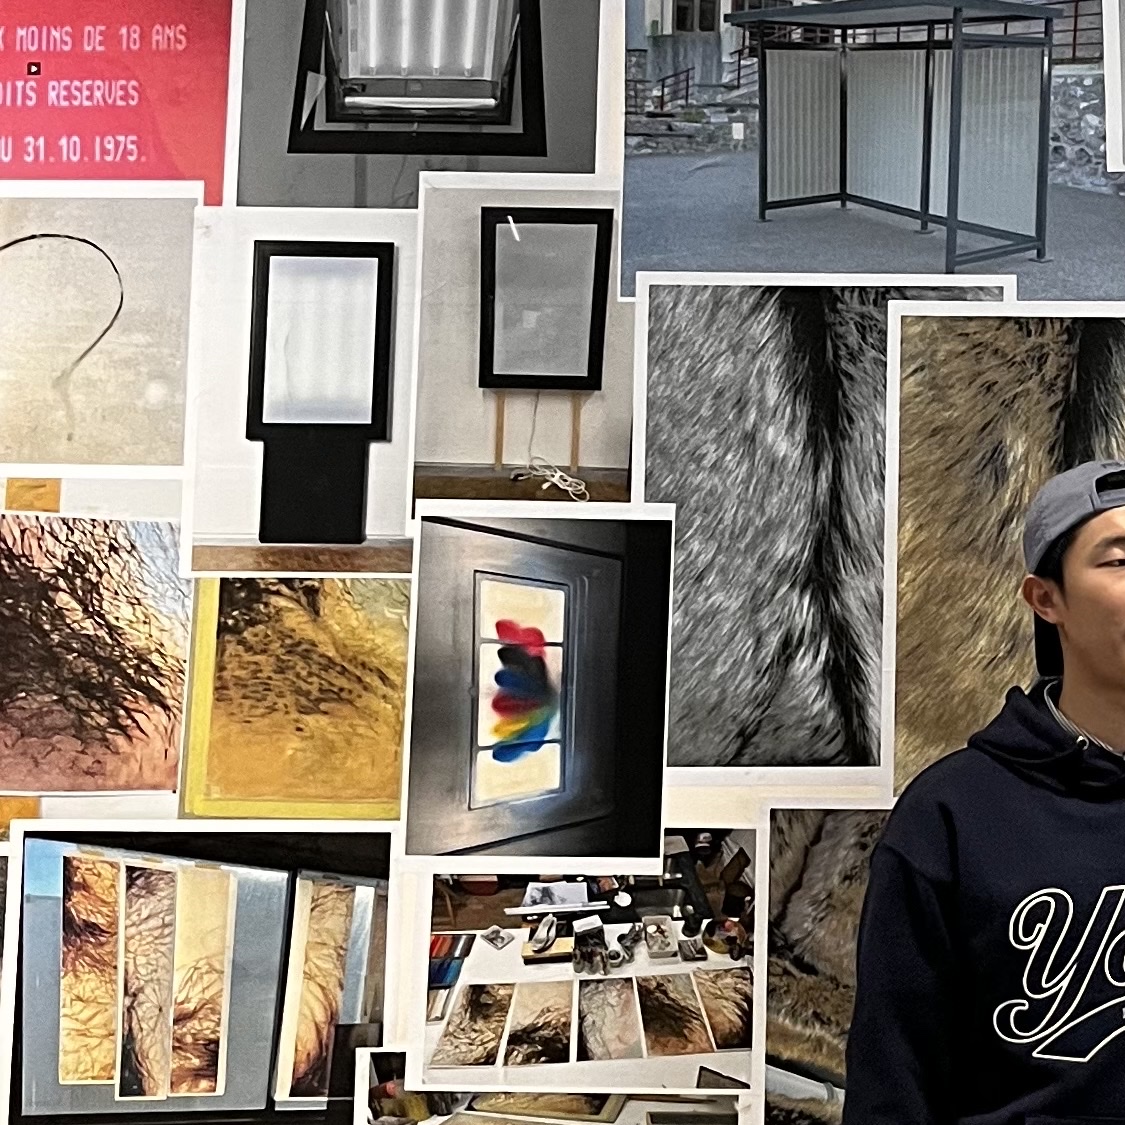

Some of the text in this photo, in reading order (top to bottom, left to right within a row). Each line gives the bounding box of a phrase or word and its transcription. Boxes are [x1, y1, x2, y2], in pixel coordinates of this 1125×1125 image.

[16, 25, 72, 52] MOINS
[84, 25, 106, 51] DE
[119, 24, 140, 50] 18
[152, 24, 187, 50] ANS
[0, 80, 139, 107] ITS RESERVES
[24, 135, 146, 163] 31.10.1975.
